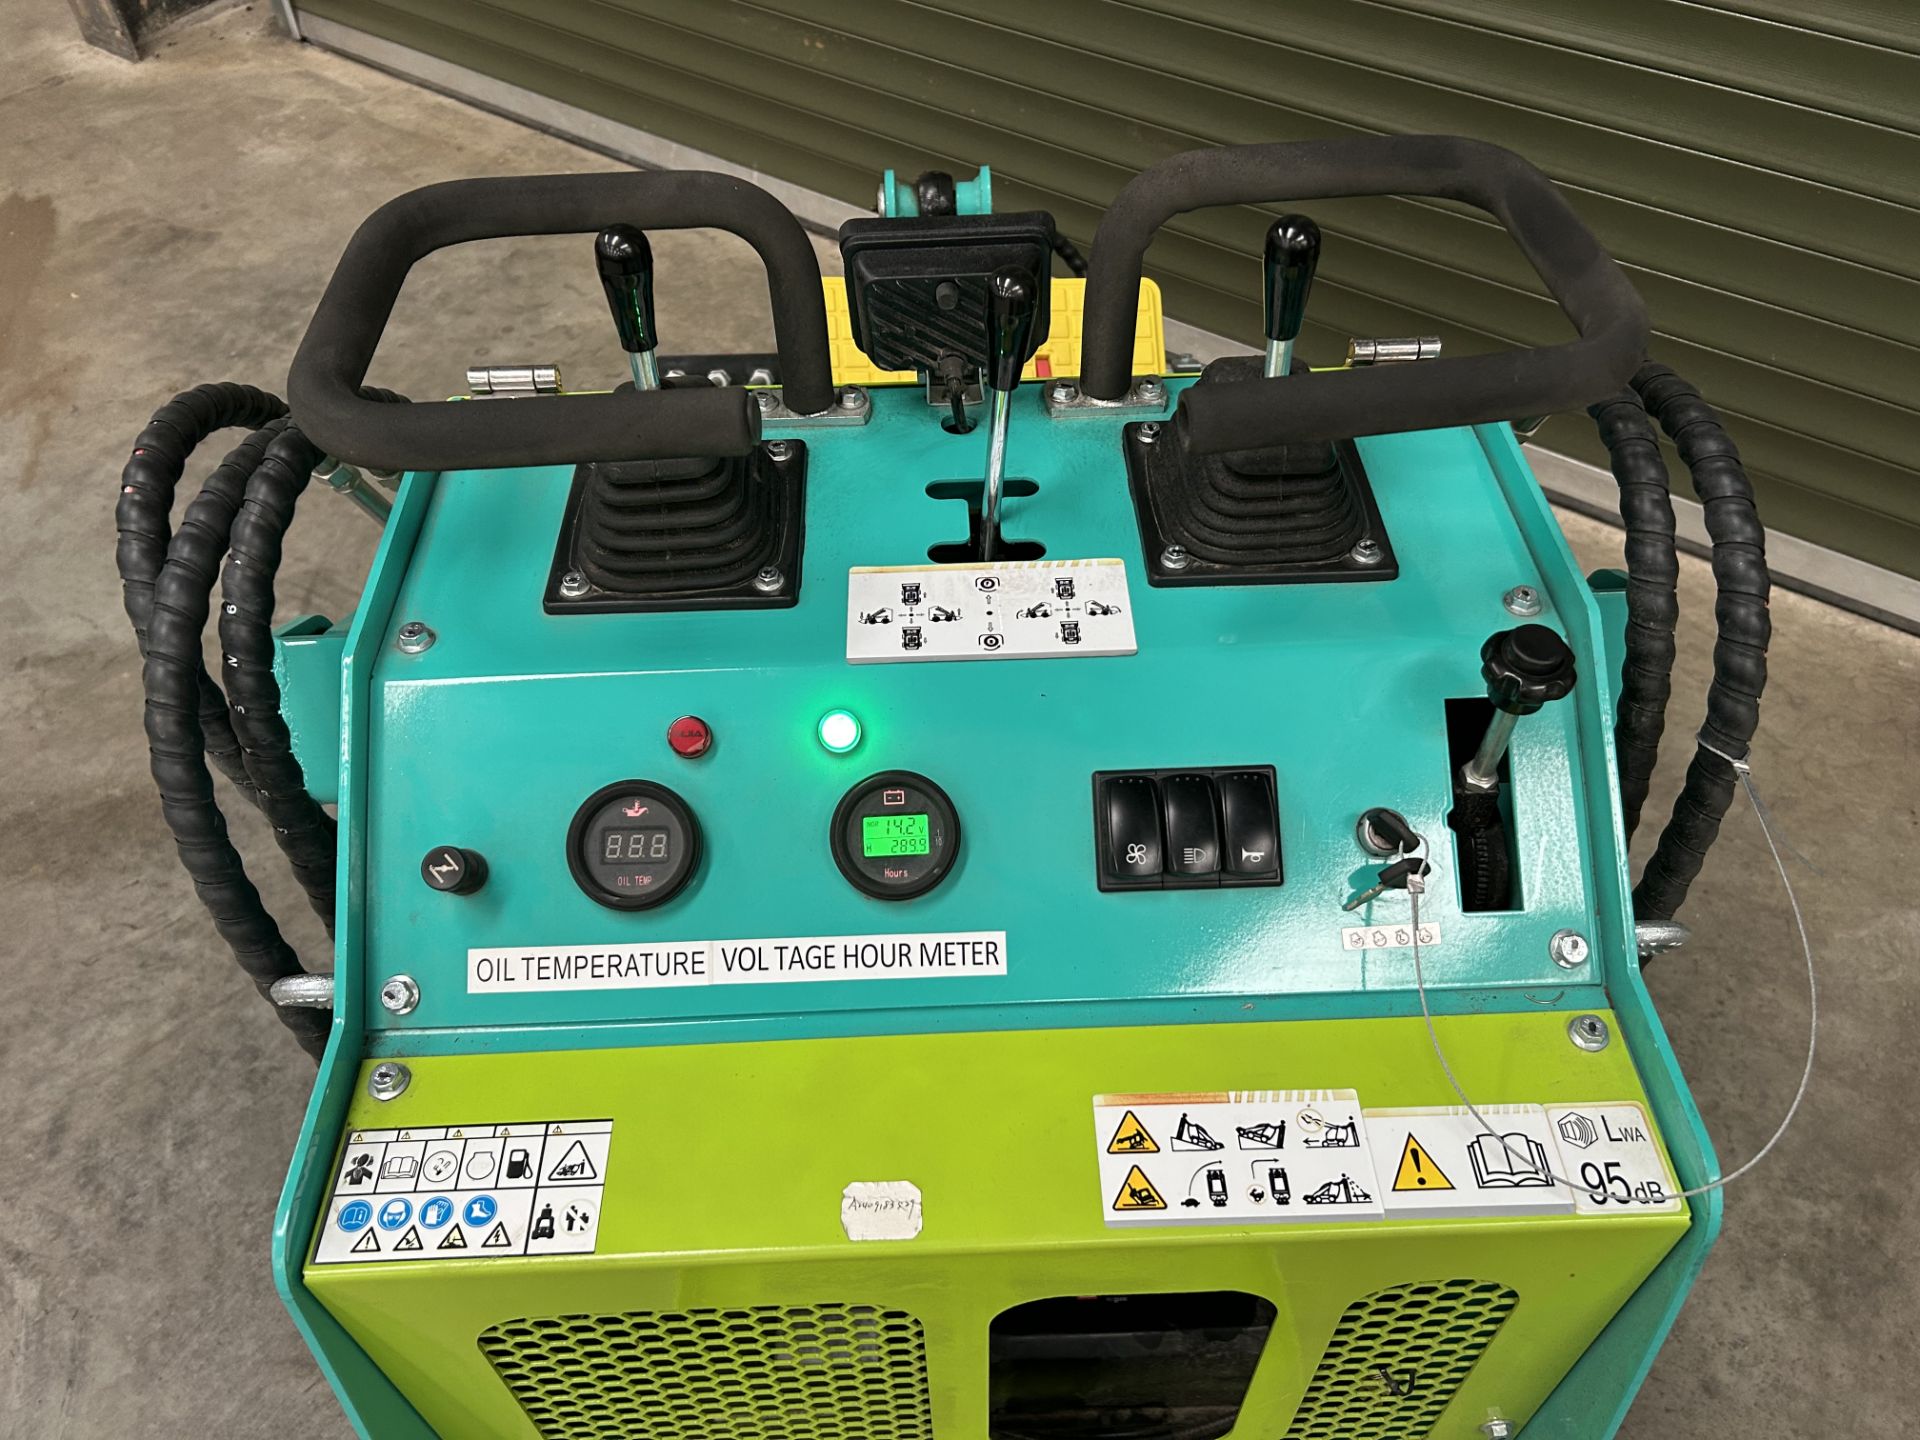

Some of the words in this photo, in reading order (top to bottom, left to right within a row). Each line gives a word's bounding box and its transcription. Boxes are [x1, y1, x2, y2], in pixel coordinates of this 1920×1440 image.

[886, 817, 916, 836] 14.2
[618, 876, 630, 886] OIL
[635, 875, 652, 886] TEMP
[884, 868, 908, 878] Hours
[843, 943, 913, 969] HOUR
[919, 940, 1000, 967] METER
[476, 957, 516, 983] OIL
[521, 950, 706, 981] TEMPERATURE
[1600, 1114, 1647, 1142] LWA
